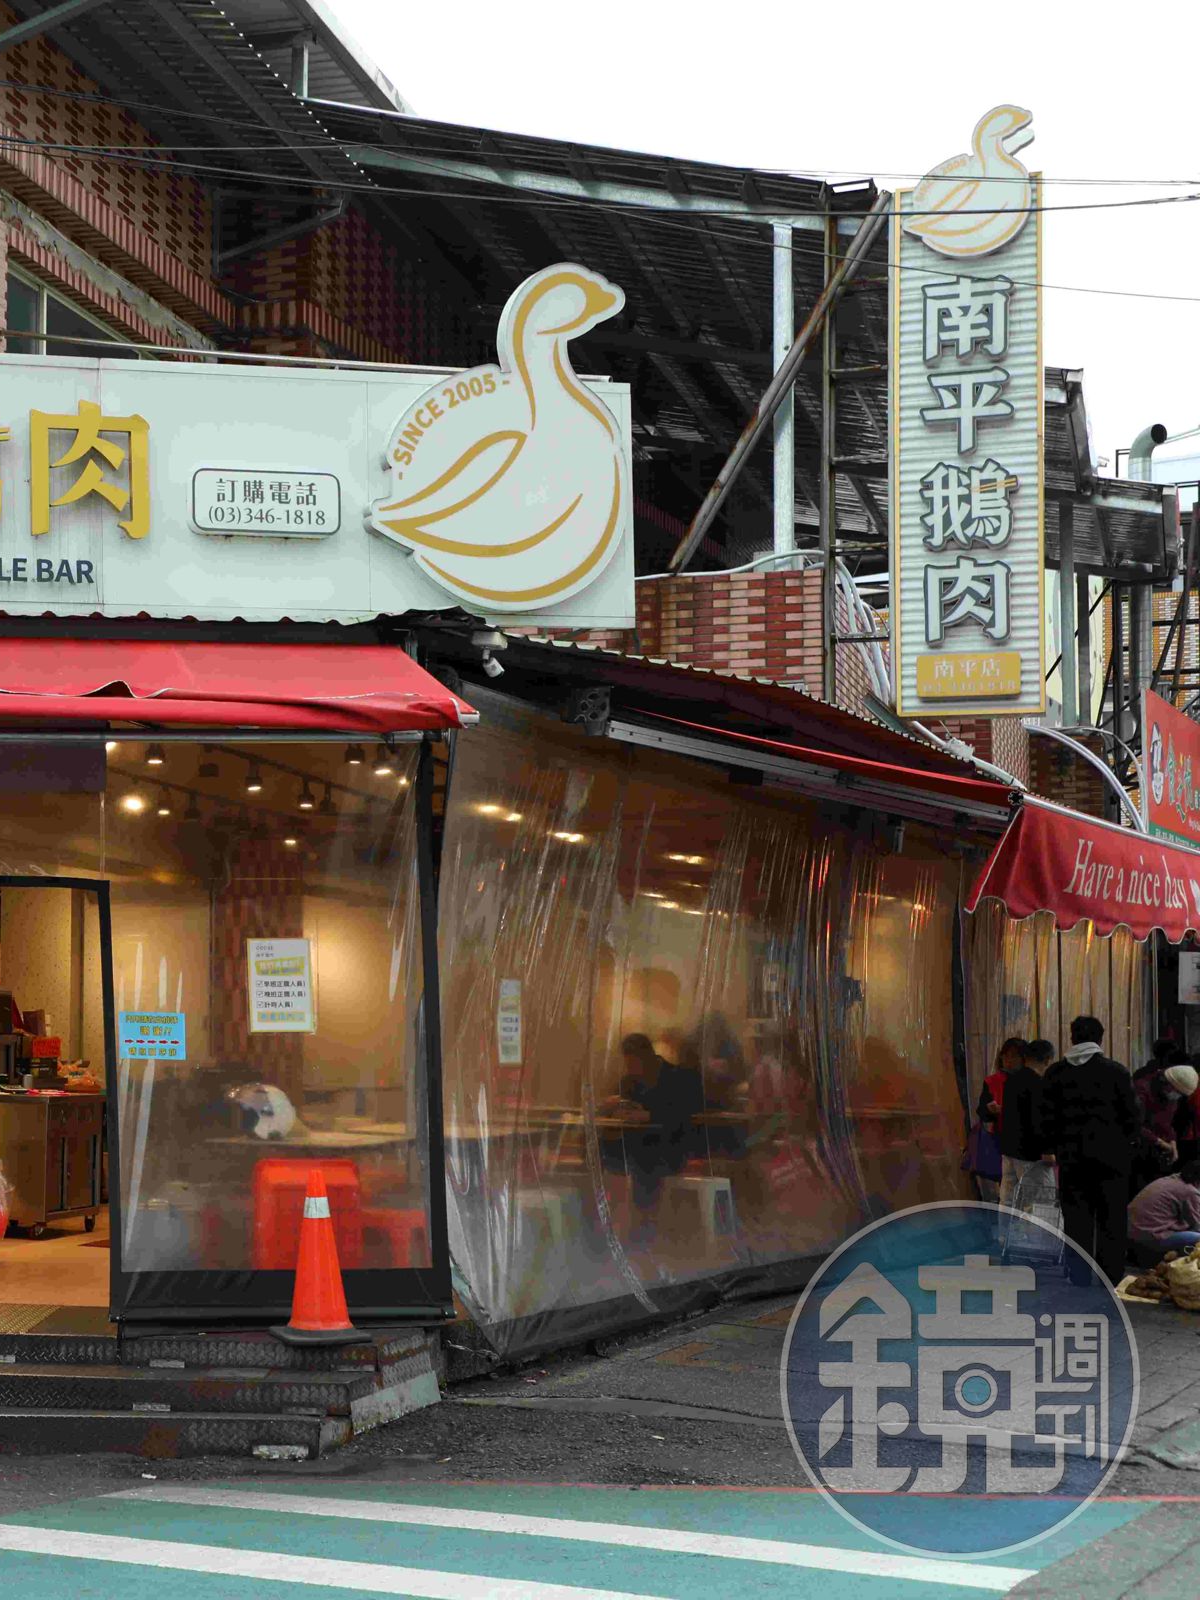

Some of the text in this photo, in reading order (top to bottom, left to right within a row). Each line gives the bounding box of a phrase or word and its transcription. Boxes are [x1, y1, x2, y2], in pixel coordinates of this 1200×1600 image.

[393, 373, 497, 467] SINCE 2005
[921, 275, 1017, 646] 南平鵝肉
[216, 477, 318, 506] 訂購電話
[208, 505, 326, 526] (03)346-1818
[35, 558, 95, 585] BAR
[934, 658, 1001, 679] 南平店
[1063, 838, 1114, 900] Have
[1115, 867, 1124, 903] a
[1126, 855, 1161, 907] nice
[1161, 855, 1190, 927] day
